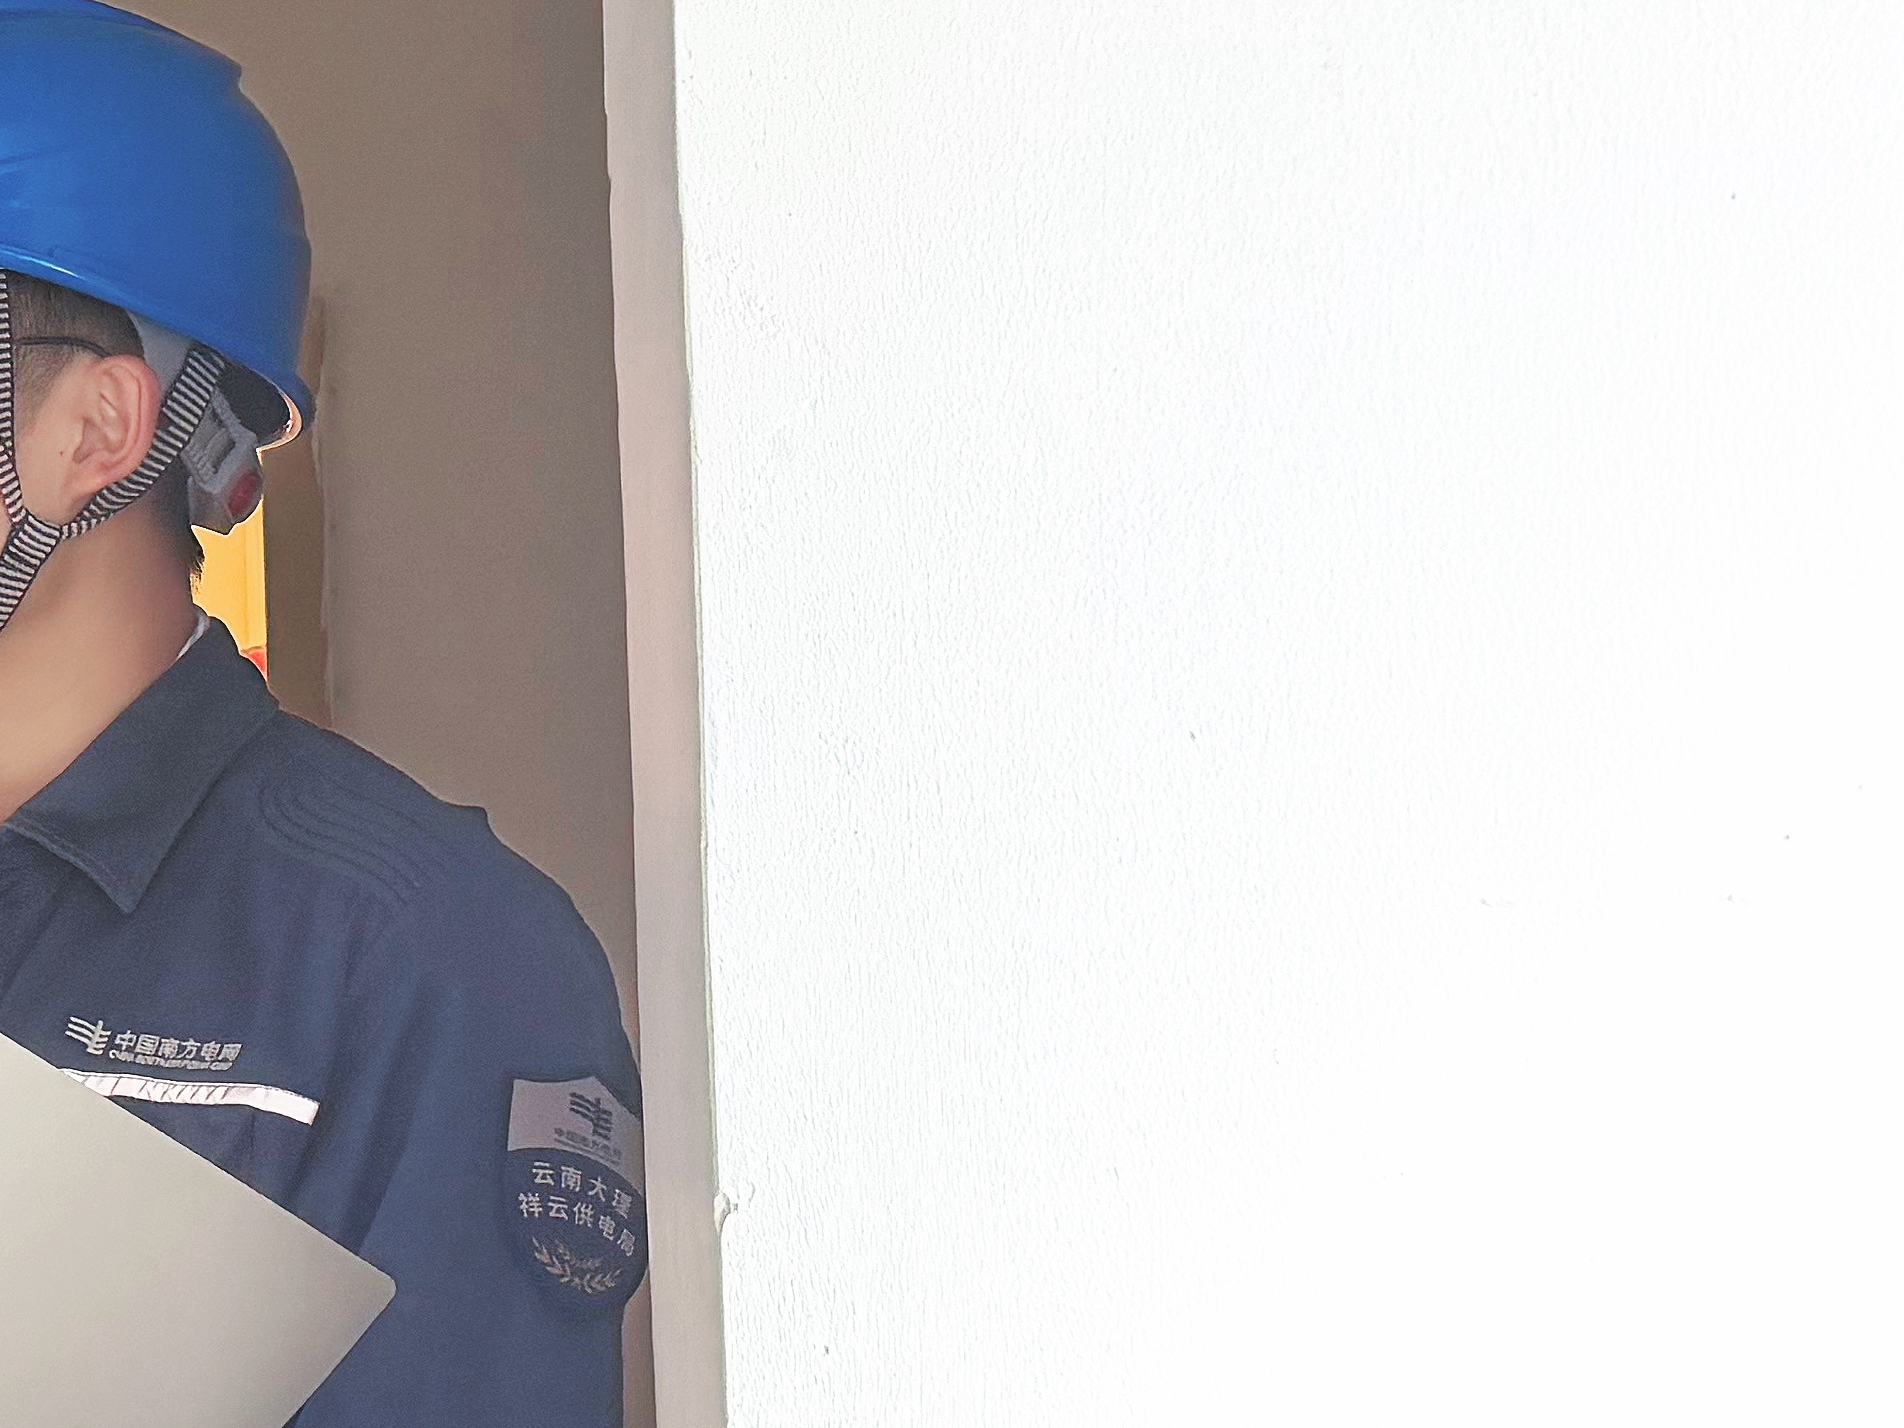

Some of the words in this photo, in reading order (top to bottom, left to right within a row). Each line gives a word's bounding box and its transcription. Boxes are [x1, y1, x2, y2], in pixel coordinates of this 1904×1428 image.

[114, 1029, 243, 1062] 中国南方电网
[532, 1161, 632, 1219] 云南大理
[518, 1193, 636, 1257] 祥云供电局
